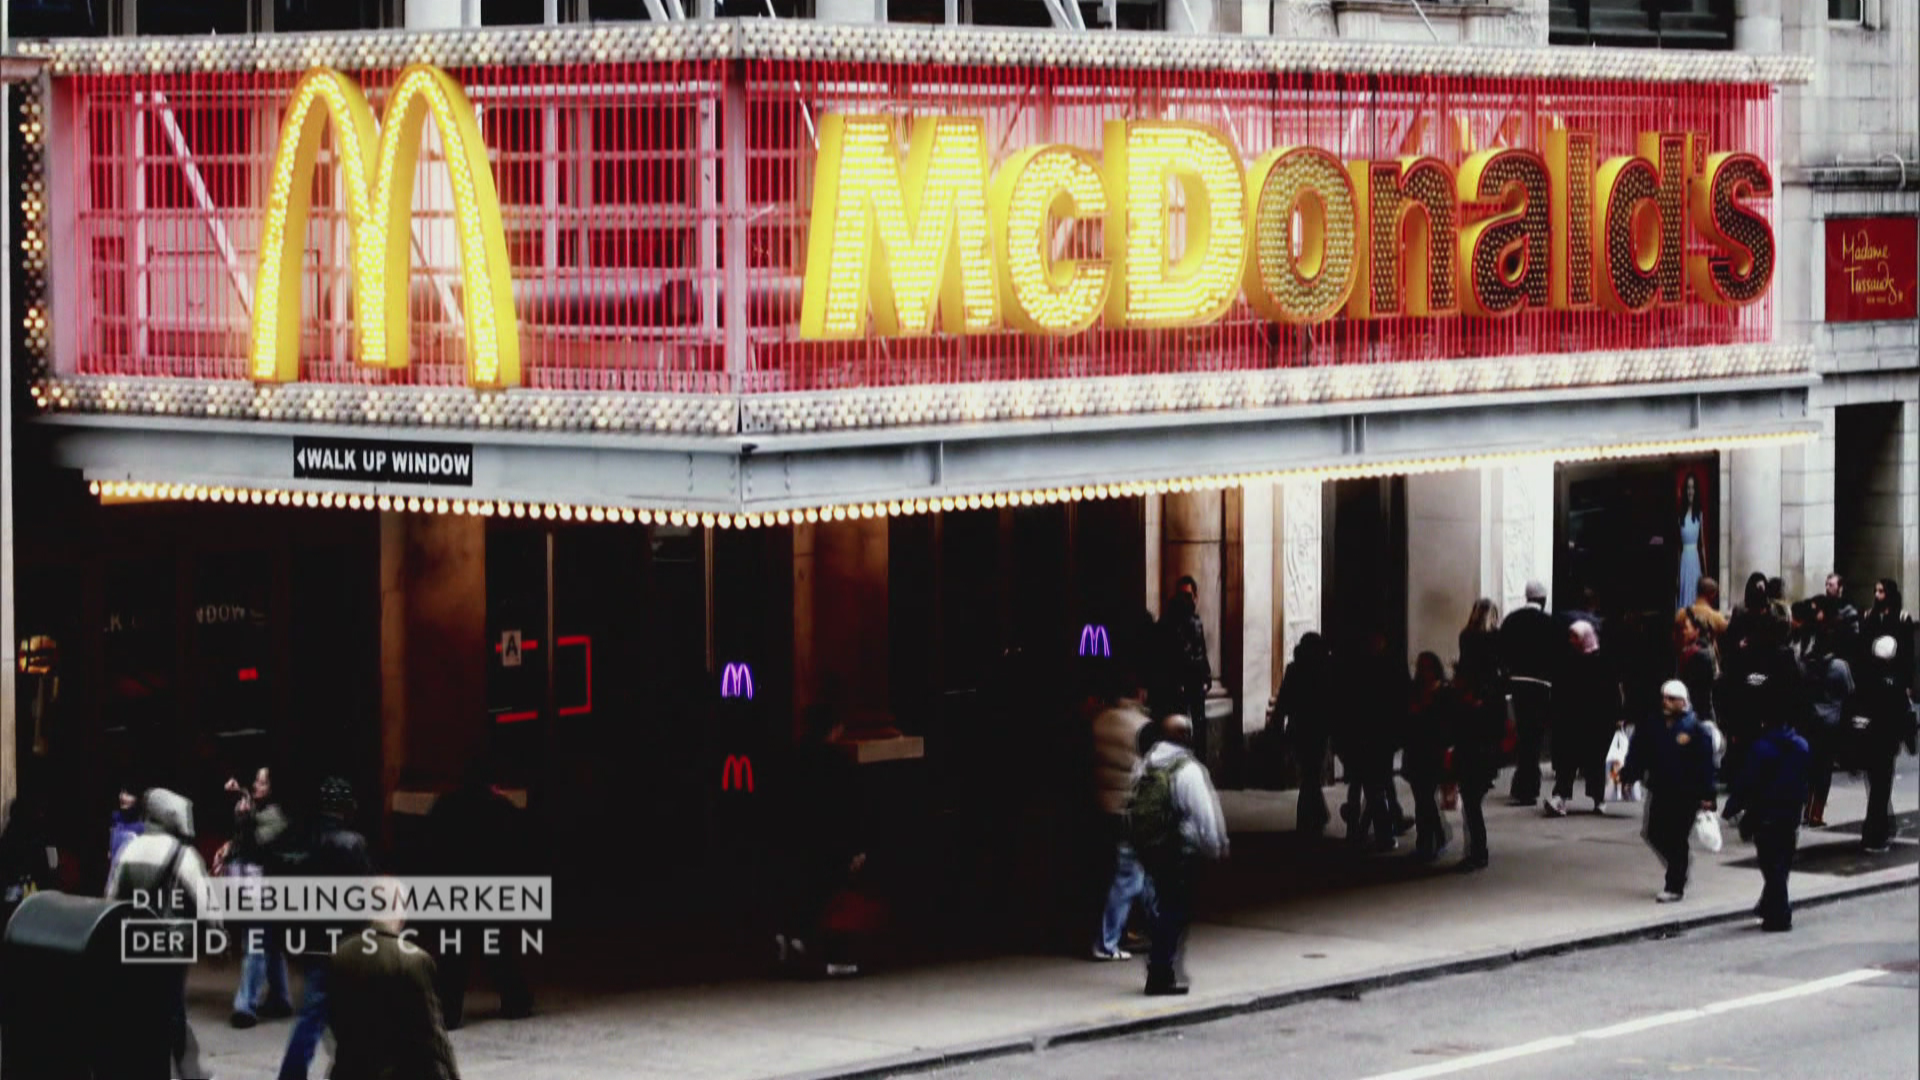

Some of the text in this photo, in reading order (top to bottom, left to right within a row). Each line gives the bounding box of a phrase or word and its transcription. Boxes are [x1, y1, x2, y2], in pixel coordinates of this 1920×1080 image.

[800, 113, 1775, 342] McDonald's
[1842, 229, 1889, 264] Madame
[307, 447, 470, 476] WALK UP WINDOW
[506, 634, 519, 657] A
